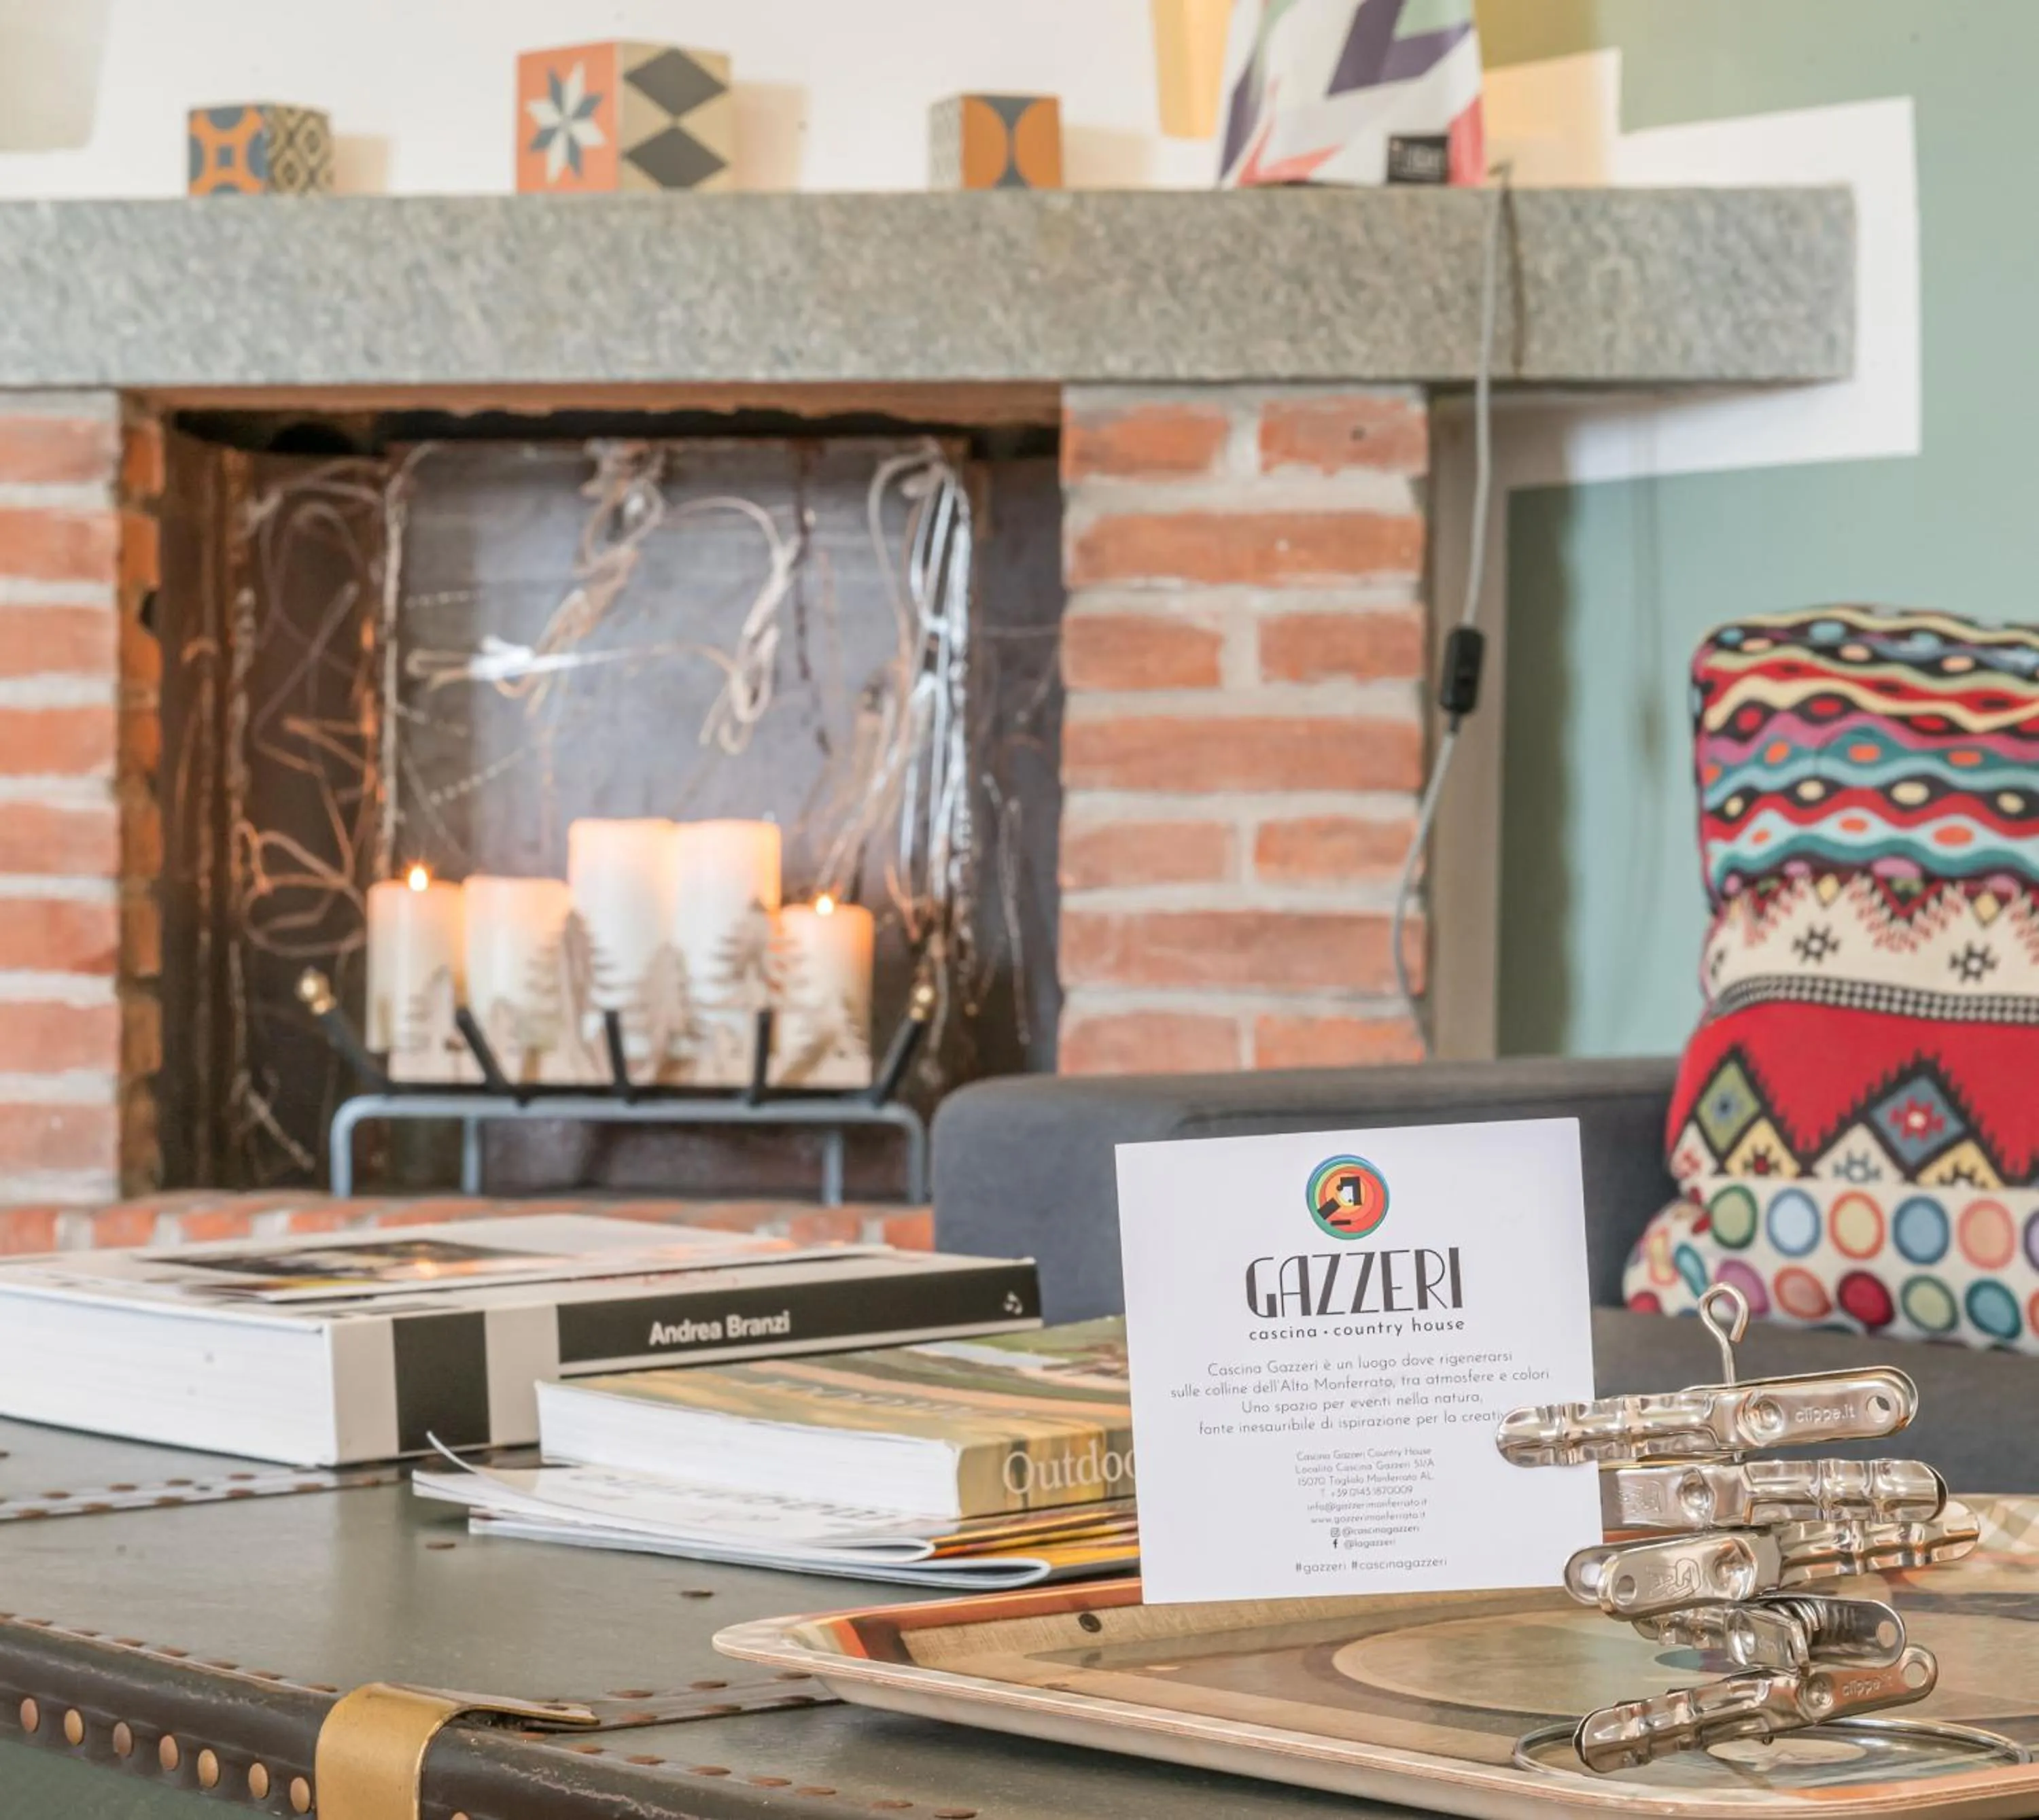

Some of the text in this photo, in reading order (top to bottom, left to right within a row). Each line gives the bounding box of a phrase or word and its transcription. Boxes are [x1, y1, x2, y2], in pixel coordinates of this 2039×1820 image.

[1246, 1247, 1463, 1318] GAZZERI
[649, 1310, 790, 1346] Andrea Branzi
[1249, 1317, 1464, 1340] cascina country house
[1208, 1352, 1513, 1376] Cascina Gazzeri è un luogo dove rigenerarsi
[1171, 1384, 1200, 1398] sulle
[1205, 1382, 1248, 1396] colline
[1314, 1374, 1395, 1390] Monferrato,
[1402, 1375, 1421, 1385] tra
[1426, 1369, 1495, 1385] atmosfere
[1499, 1372, 1507, 1381] e
[1512, 1365, 1550, 1380] colori
[1242, 1392, 1483, 1414] Uno spazio per eventi nella natura,
[1795, 1404, 1856, 1424] clippa.it
[1200, 1422, 1234, 1435] fonte
[1239, 1417, 1315, 1433] inesauribile
[1321, 1416, 1333, 1429] di
[1339, 1414, 1410, 1430] ispirazione
[1417, 1414, 1437, 1427] per
[1295, 1558, 1447, 1575] #gazzeri #cascinagazzeri
